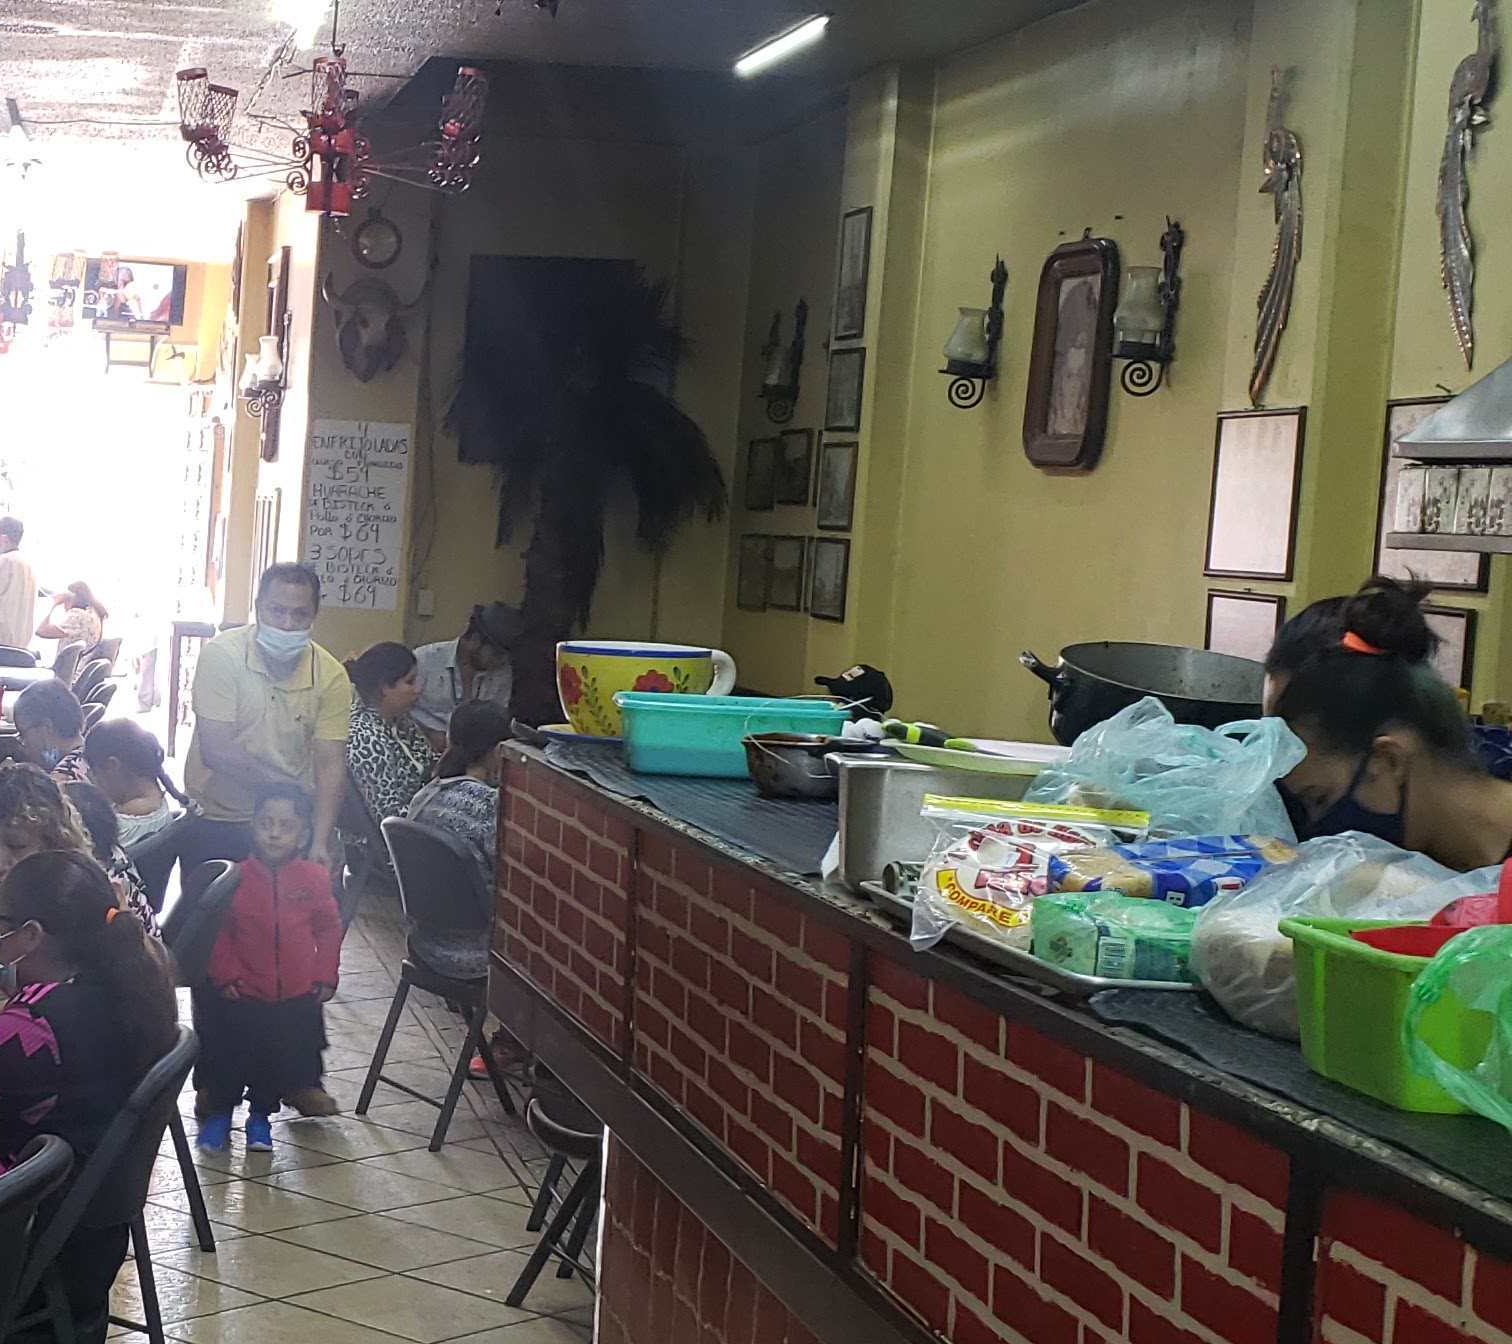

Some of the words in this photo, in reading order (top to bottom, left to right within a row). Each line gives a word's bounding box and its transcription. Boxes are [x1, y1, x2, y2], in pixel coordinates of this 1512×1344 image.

[312, 483, 387, 501] HUARACHE
[339, 522, 380, 544] $69
[310, 544, 322, 560] 3
[338, 584, 376, 607] $69
